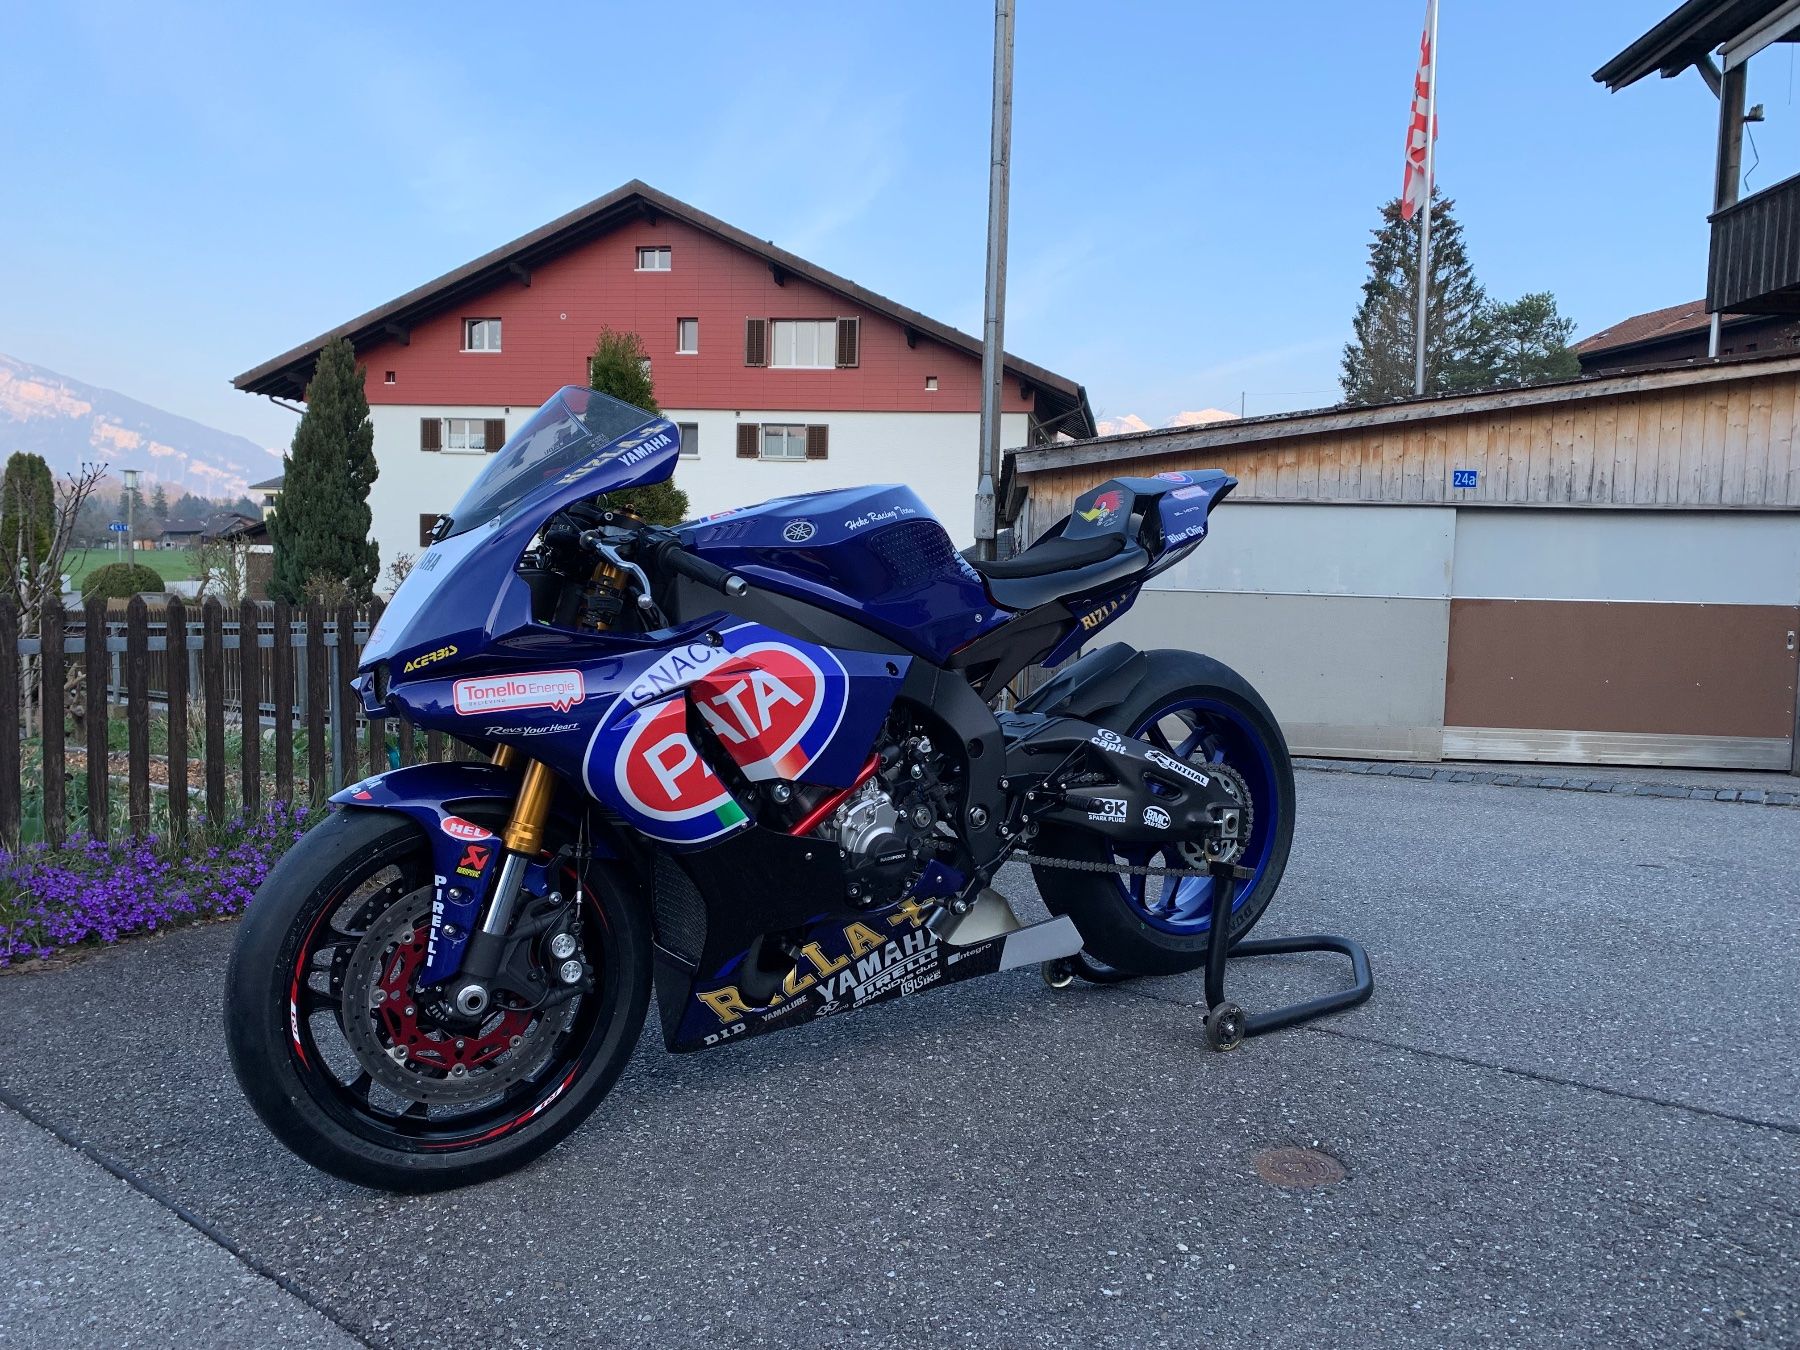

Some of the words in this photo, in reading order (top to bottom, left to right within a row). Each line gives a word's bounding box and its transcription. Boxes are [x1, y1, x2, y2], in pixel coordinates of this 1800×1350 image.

[618, 433, 672, 467] YAMAHA
[1454, 472, 1476, 486] 24a
[867, 510, 898, 523] Racing
[1167, 532, 1187, 544] Blue
[1186, 524, 1205, 537] Chip
[631, 642, 719, 702] SNAC
[463, 681, 527, 701] Tonello
[528, 682, 575, 695] Energie
[484, 726, 522, 736] Revs
[522, 726, 550, 737] Your
[548, 722, 580, 732] Heart
[642, 668, 804, 801] PATA
[1091, 737, 1128, 755] capit
[1088, 814, 1108, 822] SPARK
[1146, 809, 1169, 827] BMC
[449, 822, 484, 837] HEL
[427, 874, 448, 968] PIRELLI
[853, 945, 938, 1001] PIRELLI
[915, 961, 938, 973] duo
[761, 994, 809, 1022] YAMALUBE
